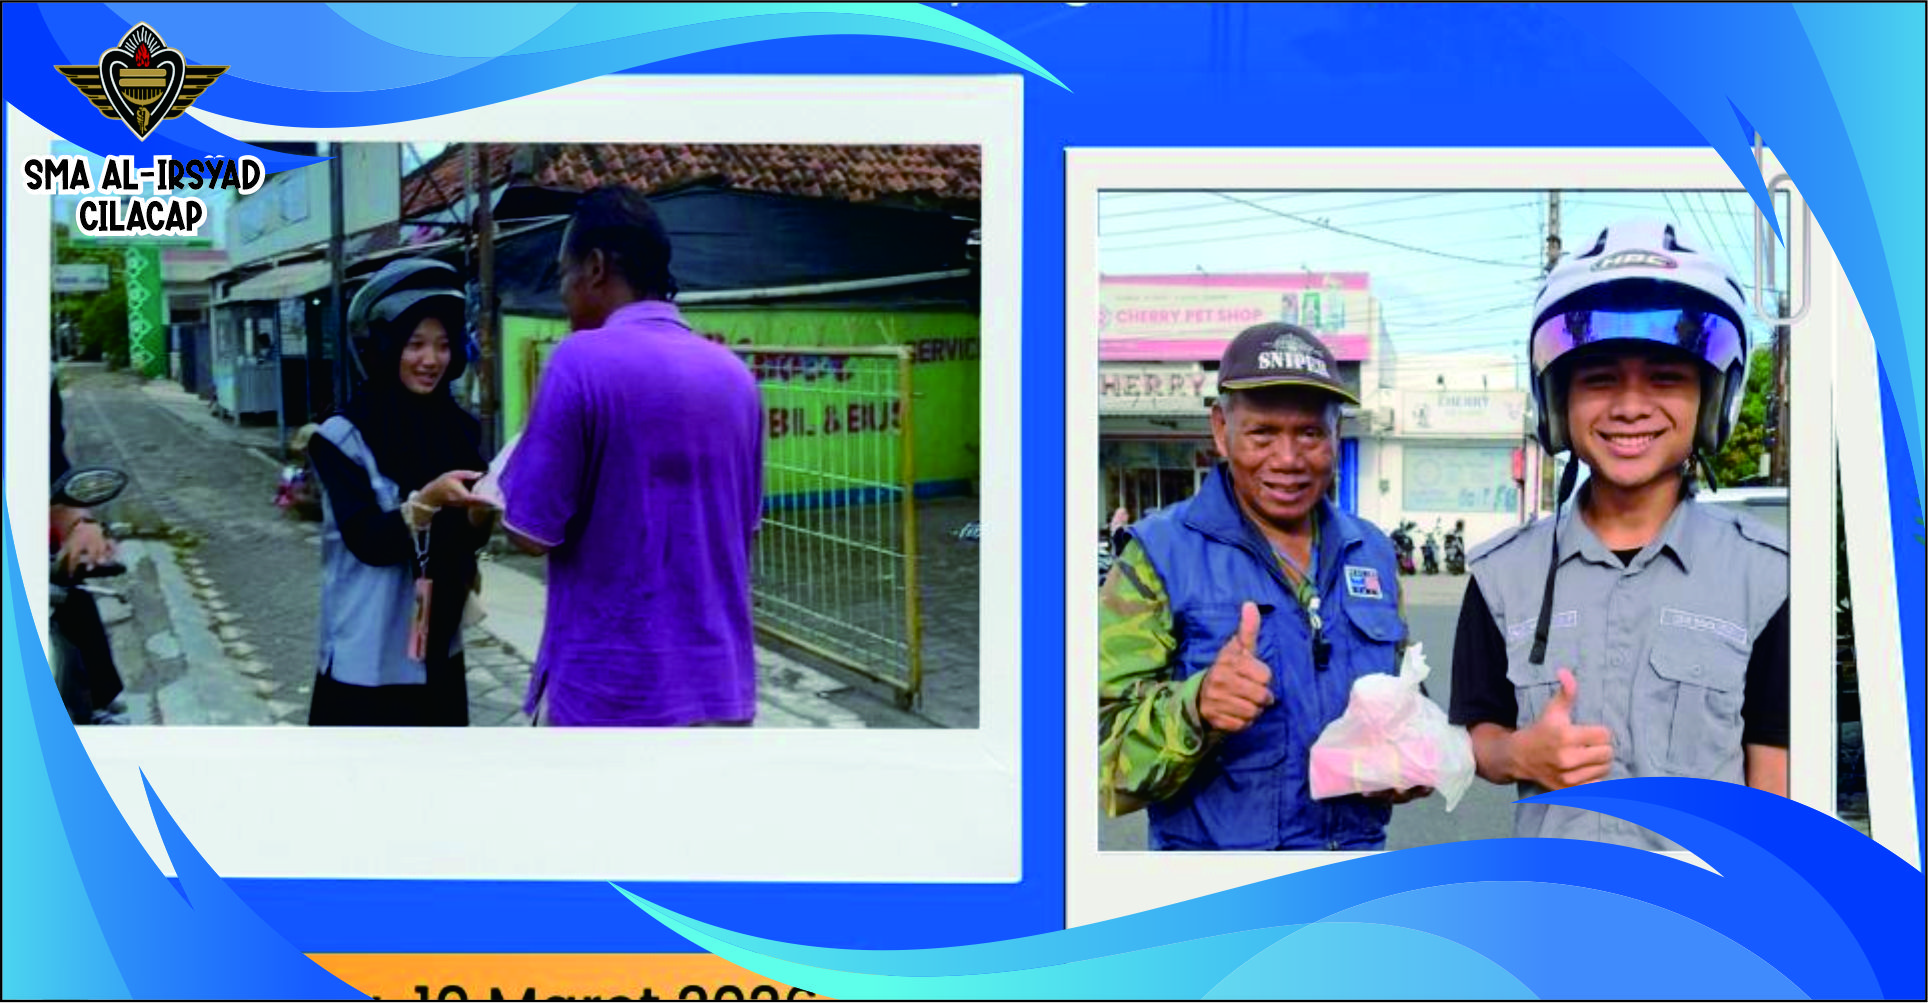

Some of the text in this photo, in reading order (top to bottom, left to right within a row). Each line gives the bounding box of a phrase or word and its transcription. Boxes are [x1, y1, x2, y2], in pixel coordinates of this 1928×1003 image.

[1116, 307, 1263, 324] CHERRY PET SHOP
[904, 337, 979, 364] SERVIC
[1100, 373, 1206, 397] HERRY
